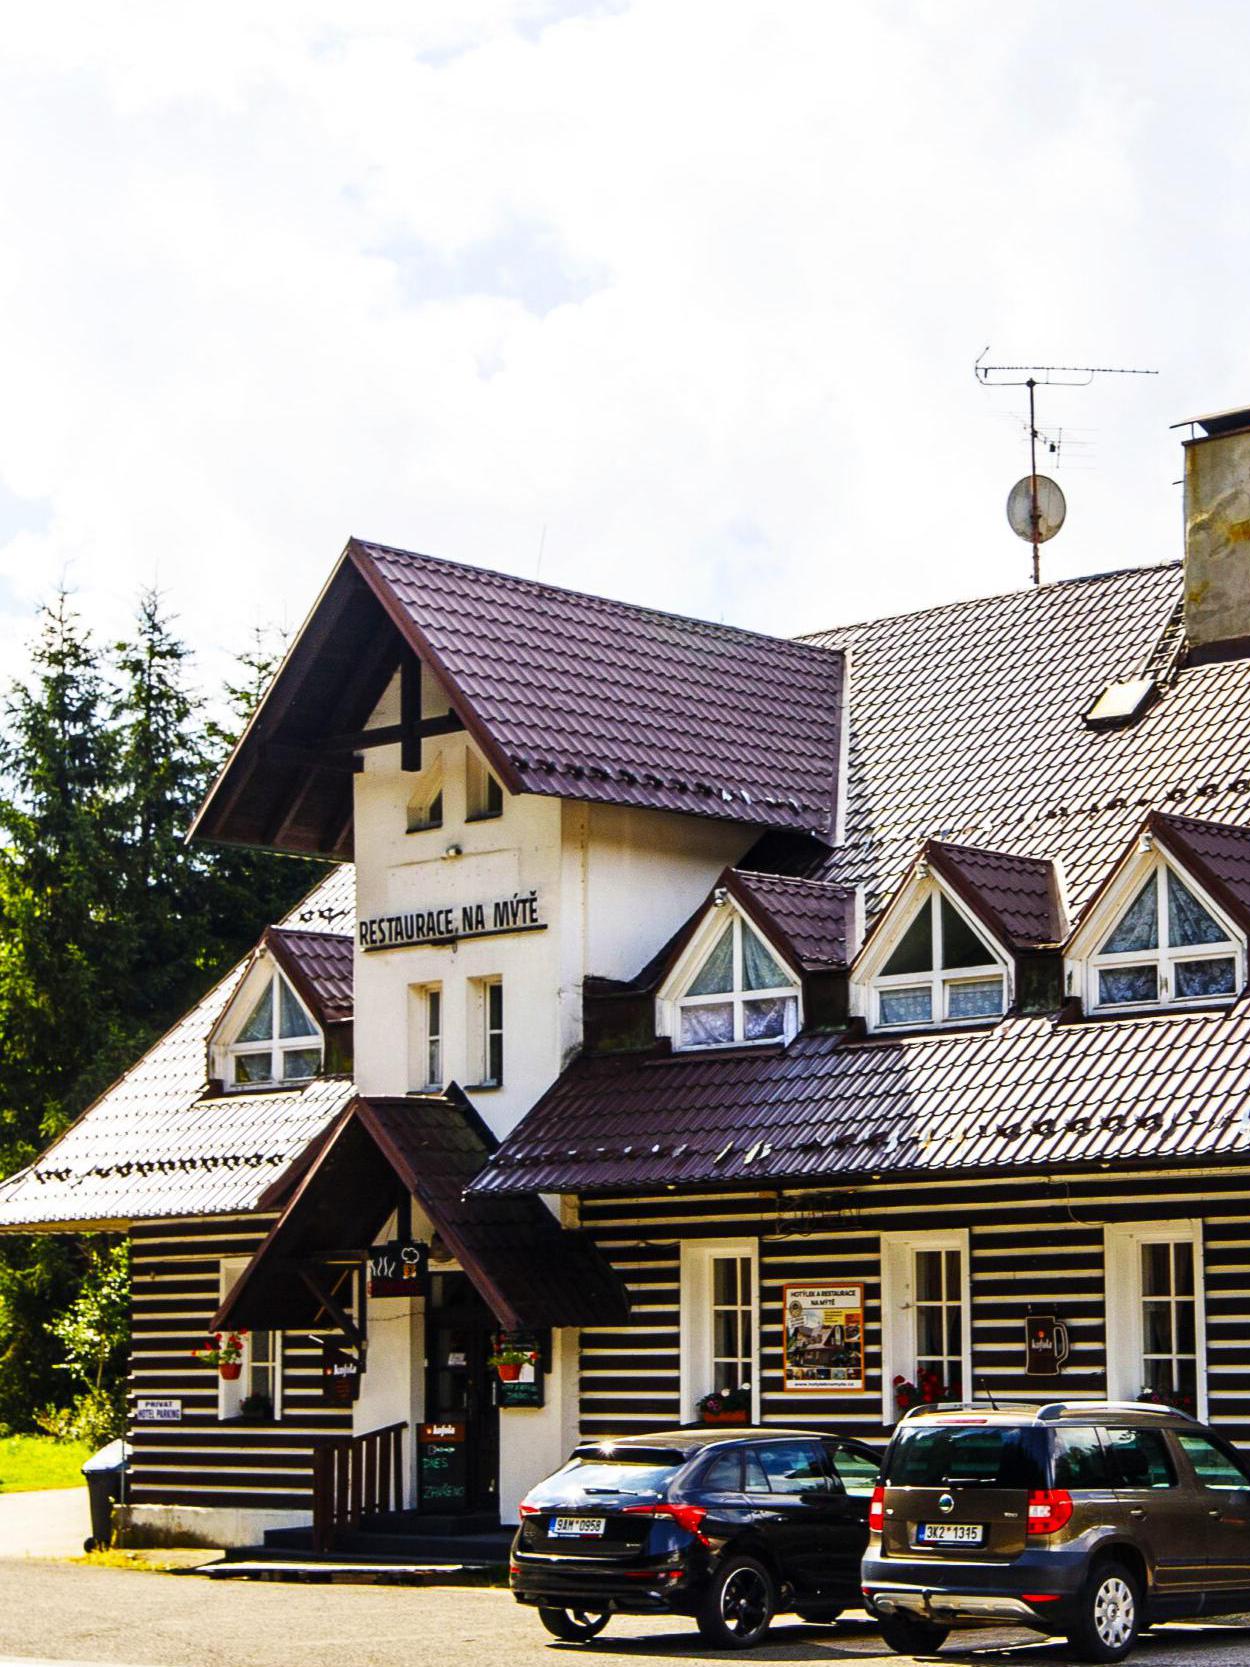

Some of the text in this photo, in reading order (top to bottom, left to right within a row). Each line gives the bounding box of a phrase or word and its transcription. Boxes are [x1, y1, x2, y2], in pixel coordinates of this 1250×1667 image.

[462, 904, 486, 932] NA
[493, 890, 539, 928] MÝTĚ
[556, 1518, 573, 1531] 9AM
[926, 1526, 978, 1540] 3K2 1315
